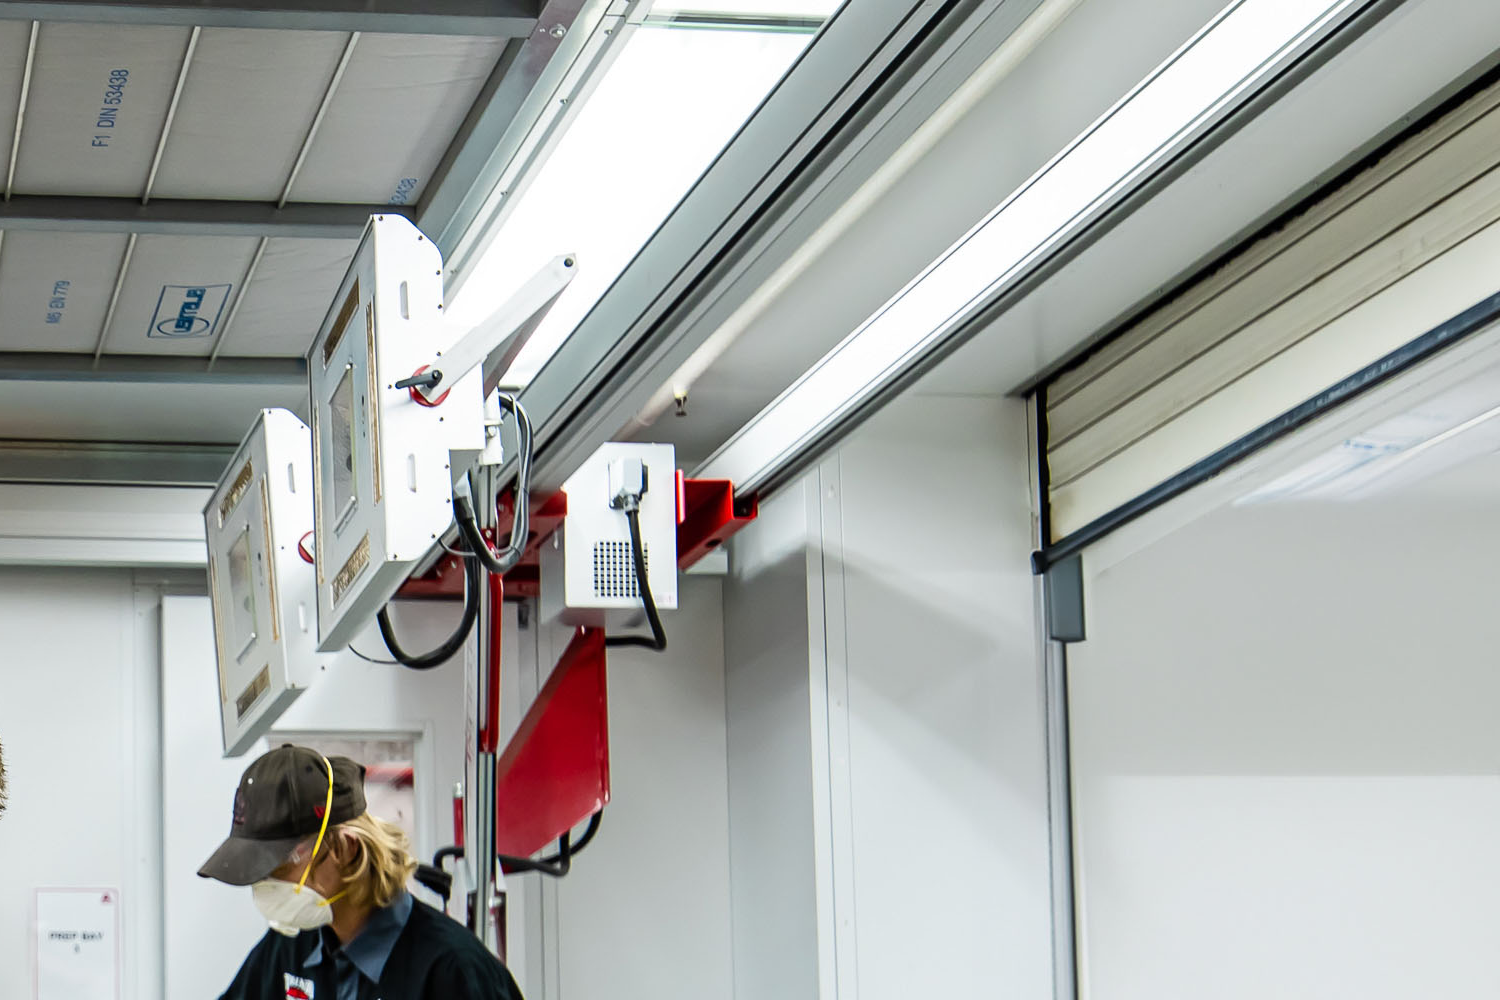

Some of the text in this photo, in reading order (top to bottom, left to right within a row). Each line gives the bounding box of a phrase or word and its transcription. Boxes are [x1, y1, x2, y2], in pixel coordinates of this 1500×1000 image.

[91, 69, 130, 148] F1 DIN 53438
[52, 280, 70, 296] 779
[48, 296, 66, 309] EN
